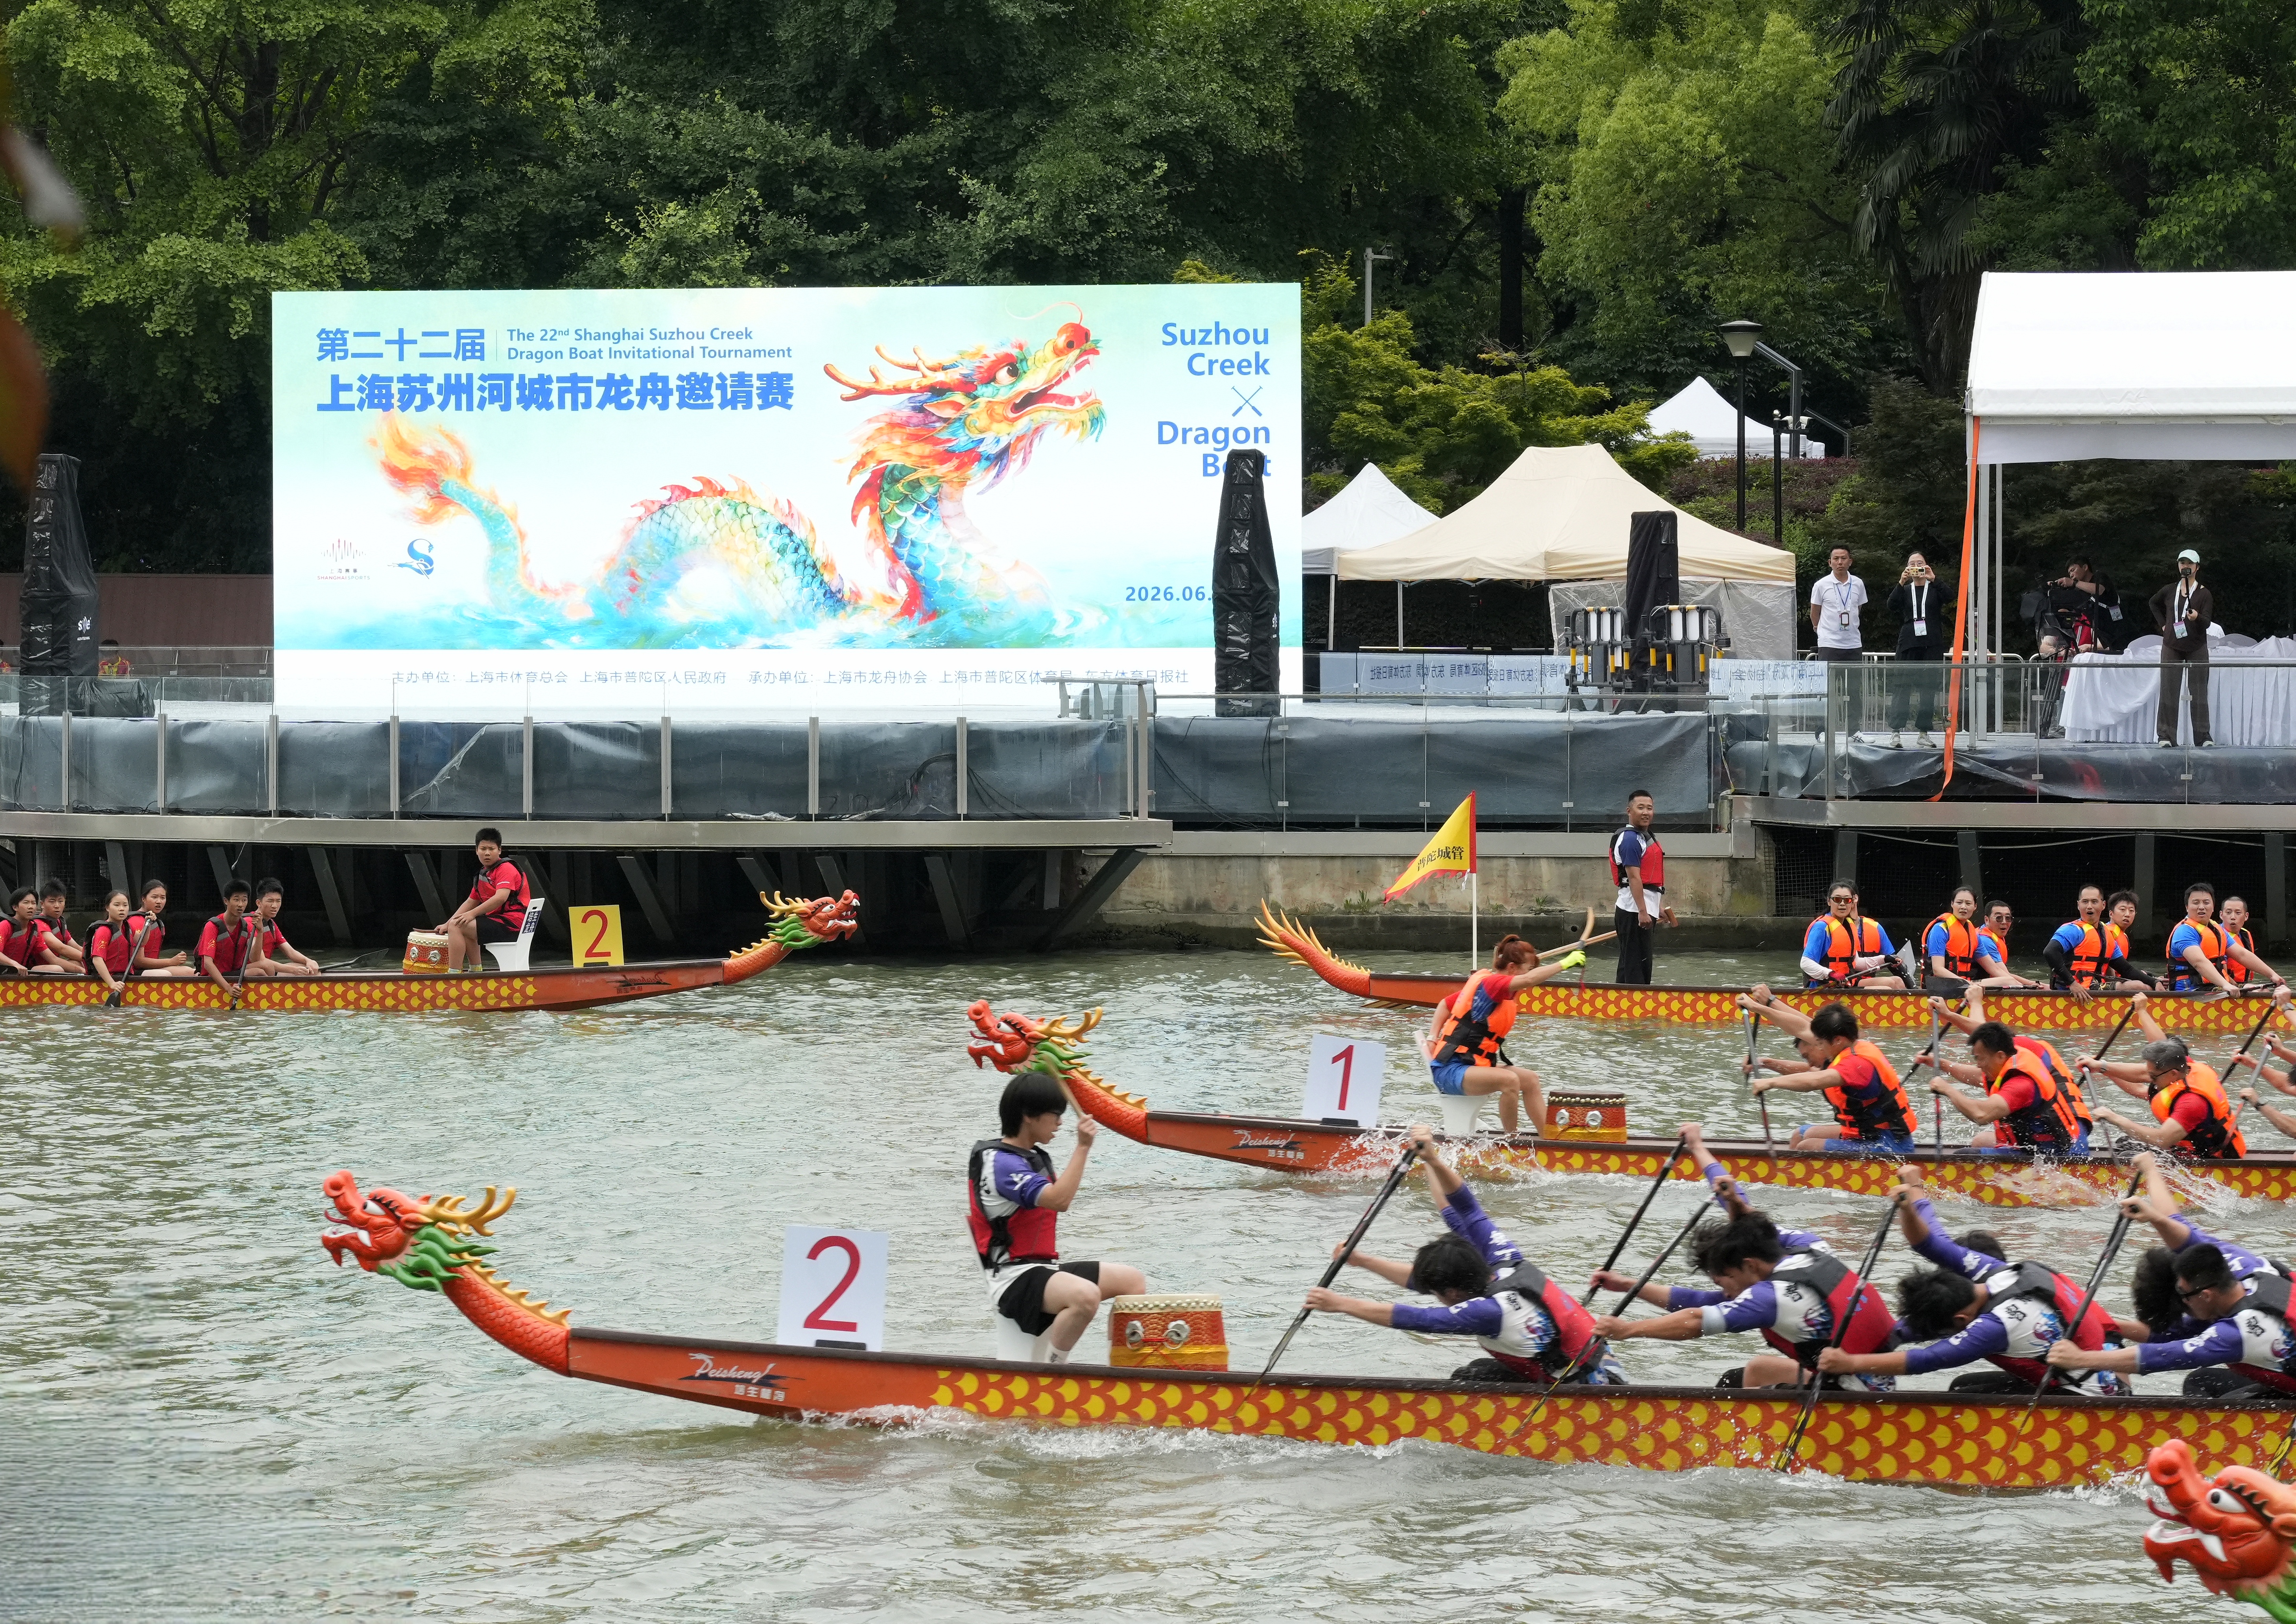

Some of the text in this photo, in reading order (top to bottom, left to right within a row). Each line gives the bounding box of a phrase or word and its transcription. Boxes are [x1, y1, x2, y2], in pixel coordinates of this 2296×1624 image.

[316, 328, 485, 362] 第二十二届
[507, 327, 753, 344] The 22nd Shanghai Suzhou Creek
[1162, 321, 1269, 346] Suzhou
[508, 346, 792, 363] Dragon Boat Invitational Tournament
[1187, 351, 1270, 376] Creek
[316, 371, 794, 412] 上海苏州河城市龙舟邀请赛
[1158, 420, 1270, 452] Dragon
[1202, 453, 1271, 478] Bt
[579, 671, 727, 685] 上海市普陀区人民政府
[823, 670, 928, 684] 上海市龙舟协会
[1417, 845, 1465, 872] 普陀城管
[581, 909, 612, 958] 2
[1331, 1045, 1354, 1111] 1
[803, 1235, 861, 1332] 2
[688, 1353, 777, 1384] Peisheng
